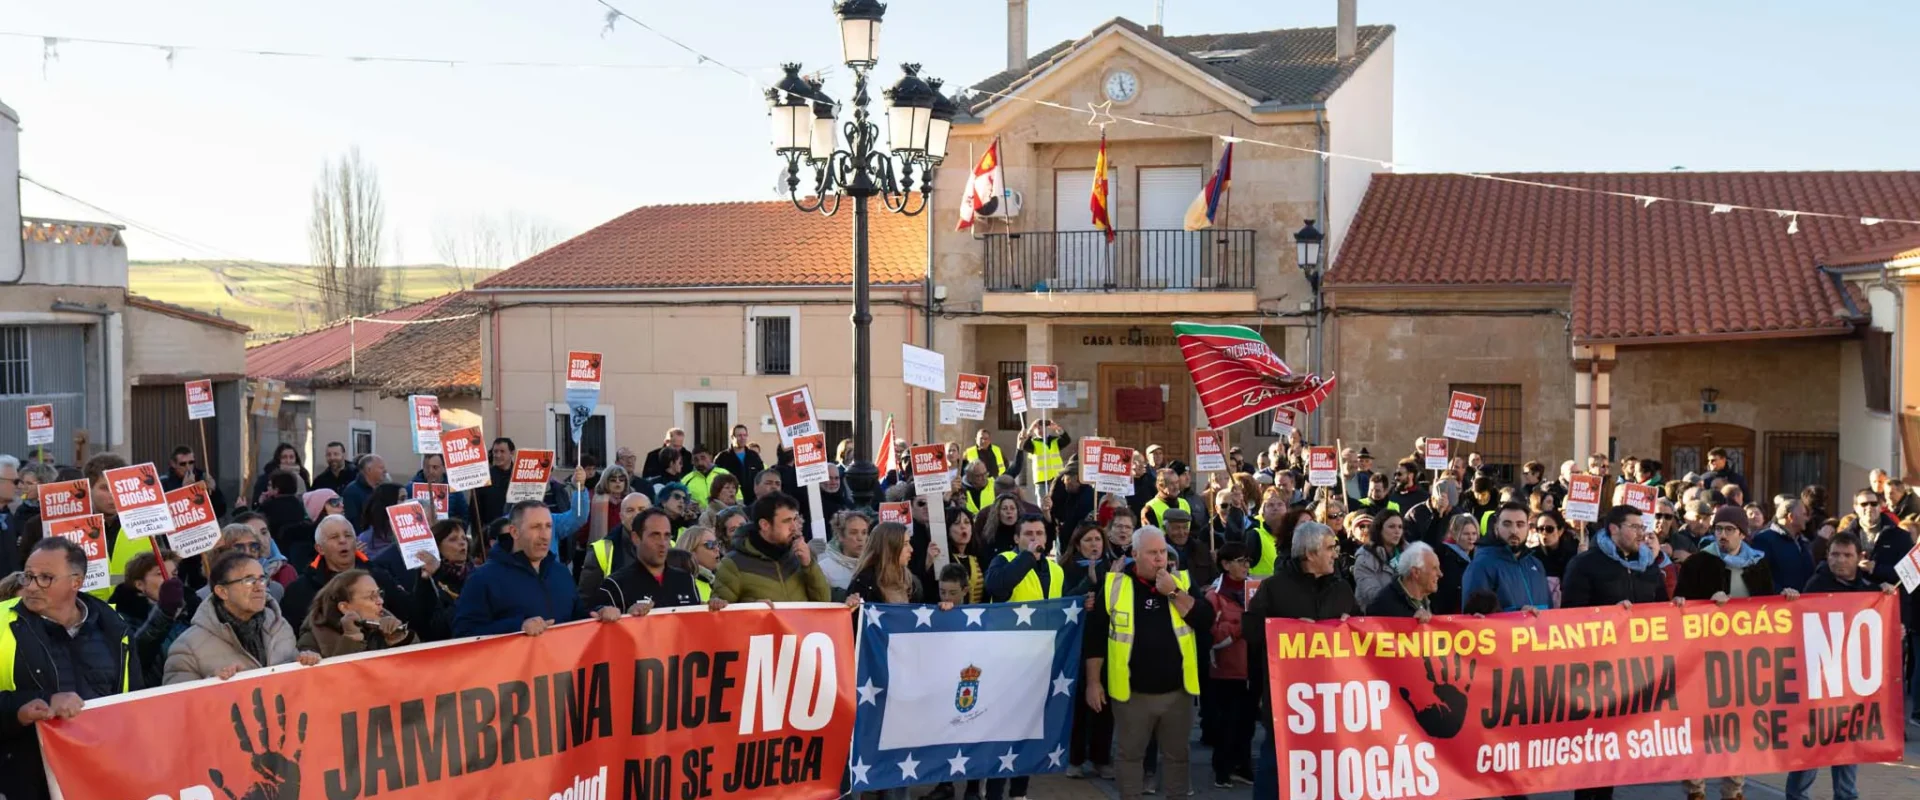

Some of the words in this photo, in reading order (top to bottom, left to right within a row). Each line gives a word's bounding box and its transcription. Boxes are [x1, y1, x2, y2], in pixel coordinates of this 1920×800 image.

[1083, 336, 1113, 346] CASA
[571, 359, 589, 368] STOP
[570, 368, 596, 379] BIOGÁS
[189, 387, 202, 395] STOP
[960, 381, 977, 390] STOP
[959, 389, 982, 400] BIOGÁS
[418, 405, 431, 416] STOP
[1454, 400, 1471, 410] STOP
[446, 438, 468, 453] STOP
[797, 443, 813, 454] STOP
[449, 447, 480, 464] BIOGÁS
[915, 453, 933, 463] STOP
[1102, 453, 1120, 463] STOP
[518, 459, 538, 469] STOP
[916, 460, 942, 473] BIOGÁS
[1101, 461, 1127, 474] BIOGÁS
[515, 467, 544, 479] BIOGÁS
[114, 478, 140, 493] STOP
[45, 491, 71, 505] STOP
[118, 487, 157, 507] BIOGÁS
[46, 500, 83, 517] BIOGÁS
[395, 514, 414, 526] STOP
[399, 524, 427, 540] BIOGÁS
[180, 536, 207, 550] JAMBRINA
[1279, 628, 1497, 659] MALVENIDOS
[1511, 620, 1617, 653] PLANTA
[1629, 616, 1669, 643] DE
[1682, 604, 1794, 639] BIOGÁS
[1481, 654, 1679, 729] JAMBRINA
[1704, 647, 1800, 709] DICE
[1802, 608, 1883, 700] NO
[1287, 680, 1391, 735] STOP
[324, 661, 613, 800] JAMBRINA
[631, 651, 739, 737] DICE
[738, 632, 838, 735] NO
[1476, 740, 1520, 773] con
[1528, 727, 1621, 768] nuestra
[1626, 717, 1693, 760] salud
[1703, 712, 1741, 754] NO
[1753, 710, 1789, 751] SE
[1802, 702, 1886, 749] JUEGA
[622, 754, 672, 800] NO
[681, 746, 715, 800] SE
[722, 736, 823, 793] JUEGA
[1289, 735, 1440, 800] BIOGÁS
